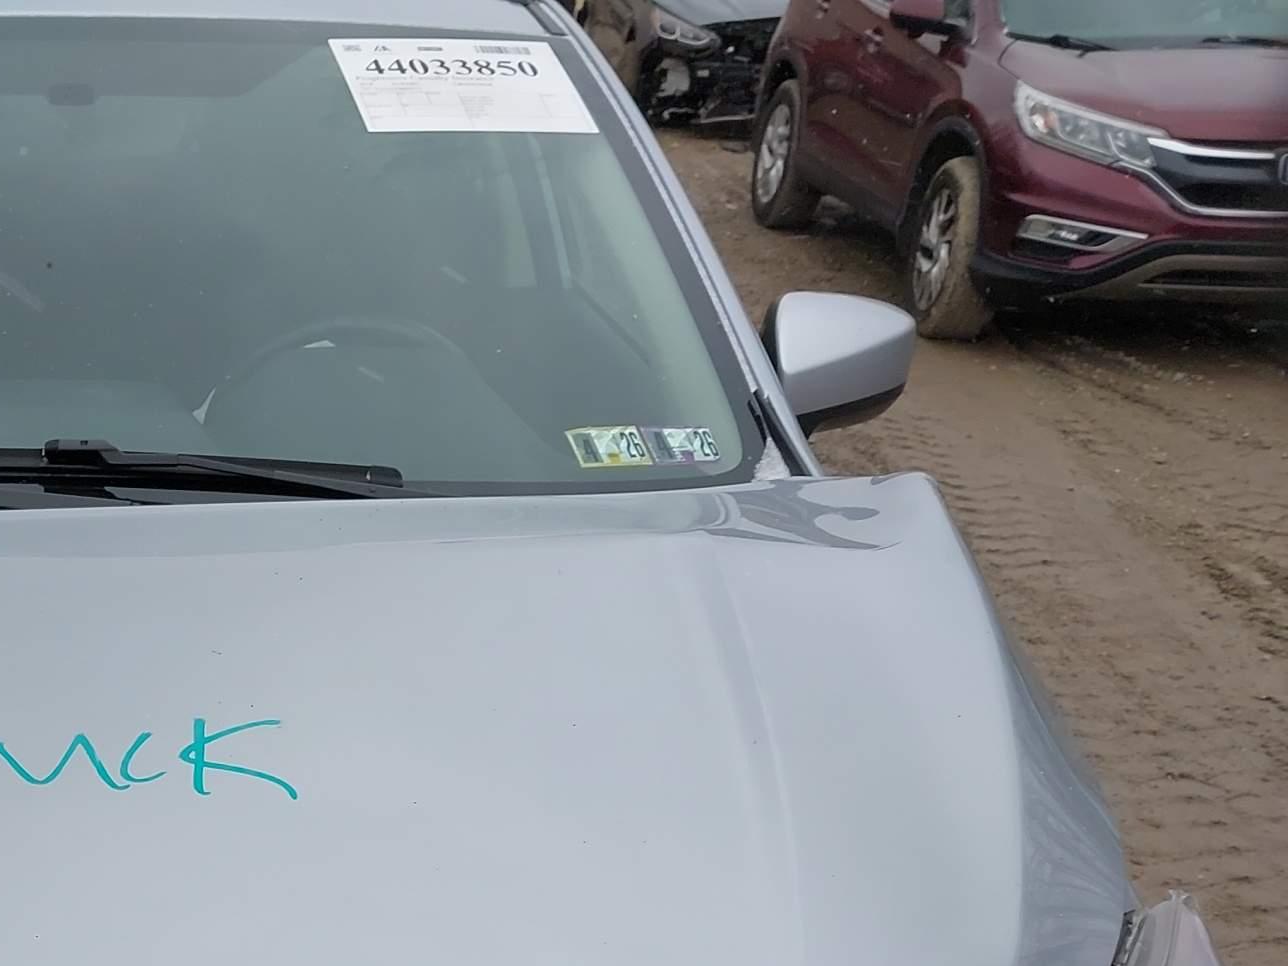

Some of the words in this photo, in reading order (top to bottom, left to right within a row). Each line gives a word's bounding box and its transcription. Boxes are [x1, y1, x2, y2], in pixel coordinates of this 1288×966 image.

[365, 58, 538, 77] 44033850
[620, 431, 646, 458] 26
[693, 430, 720, 457] 26
